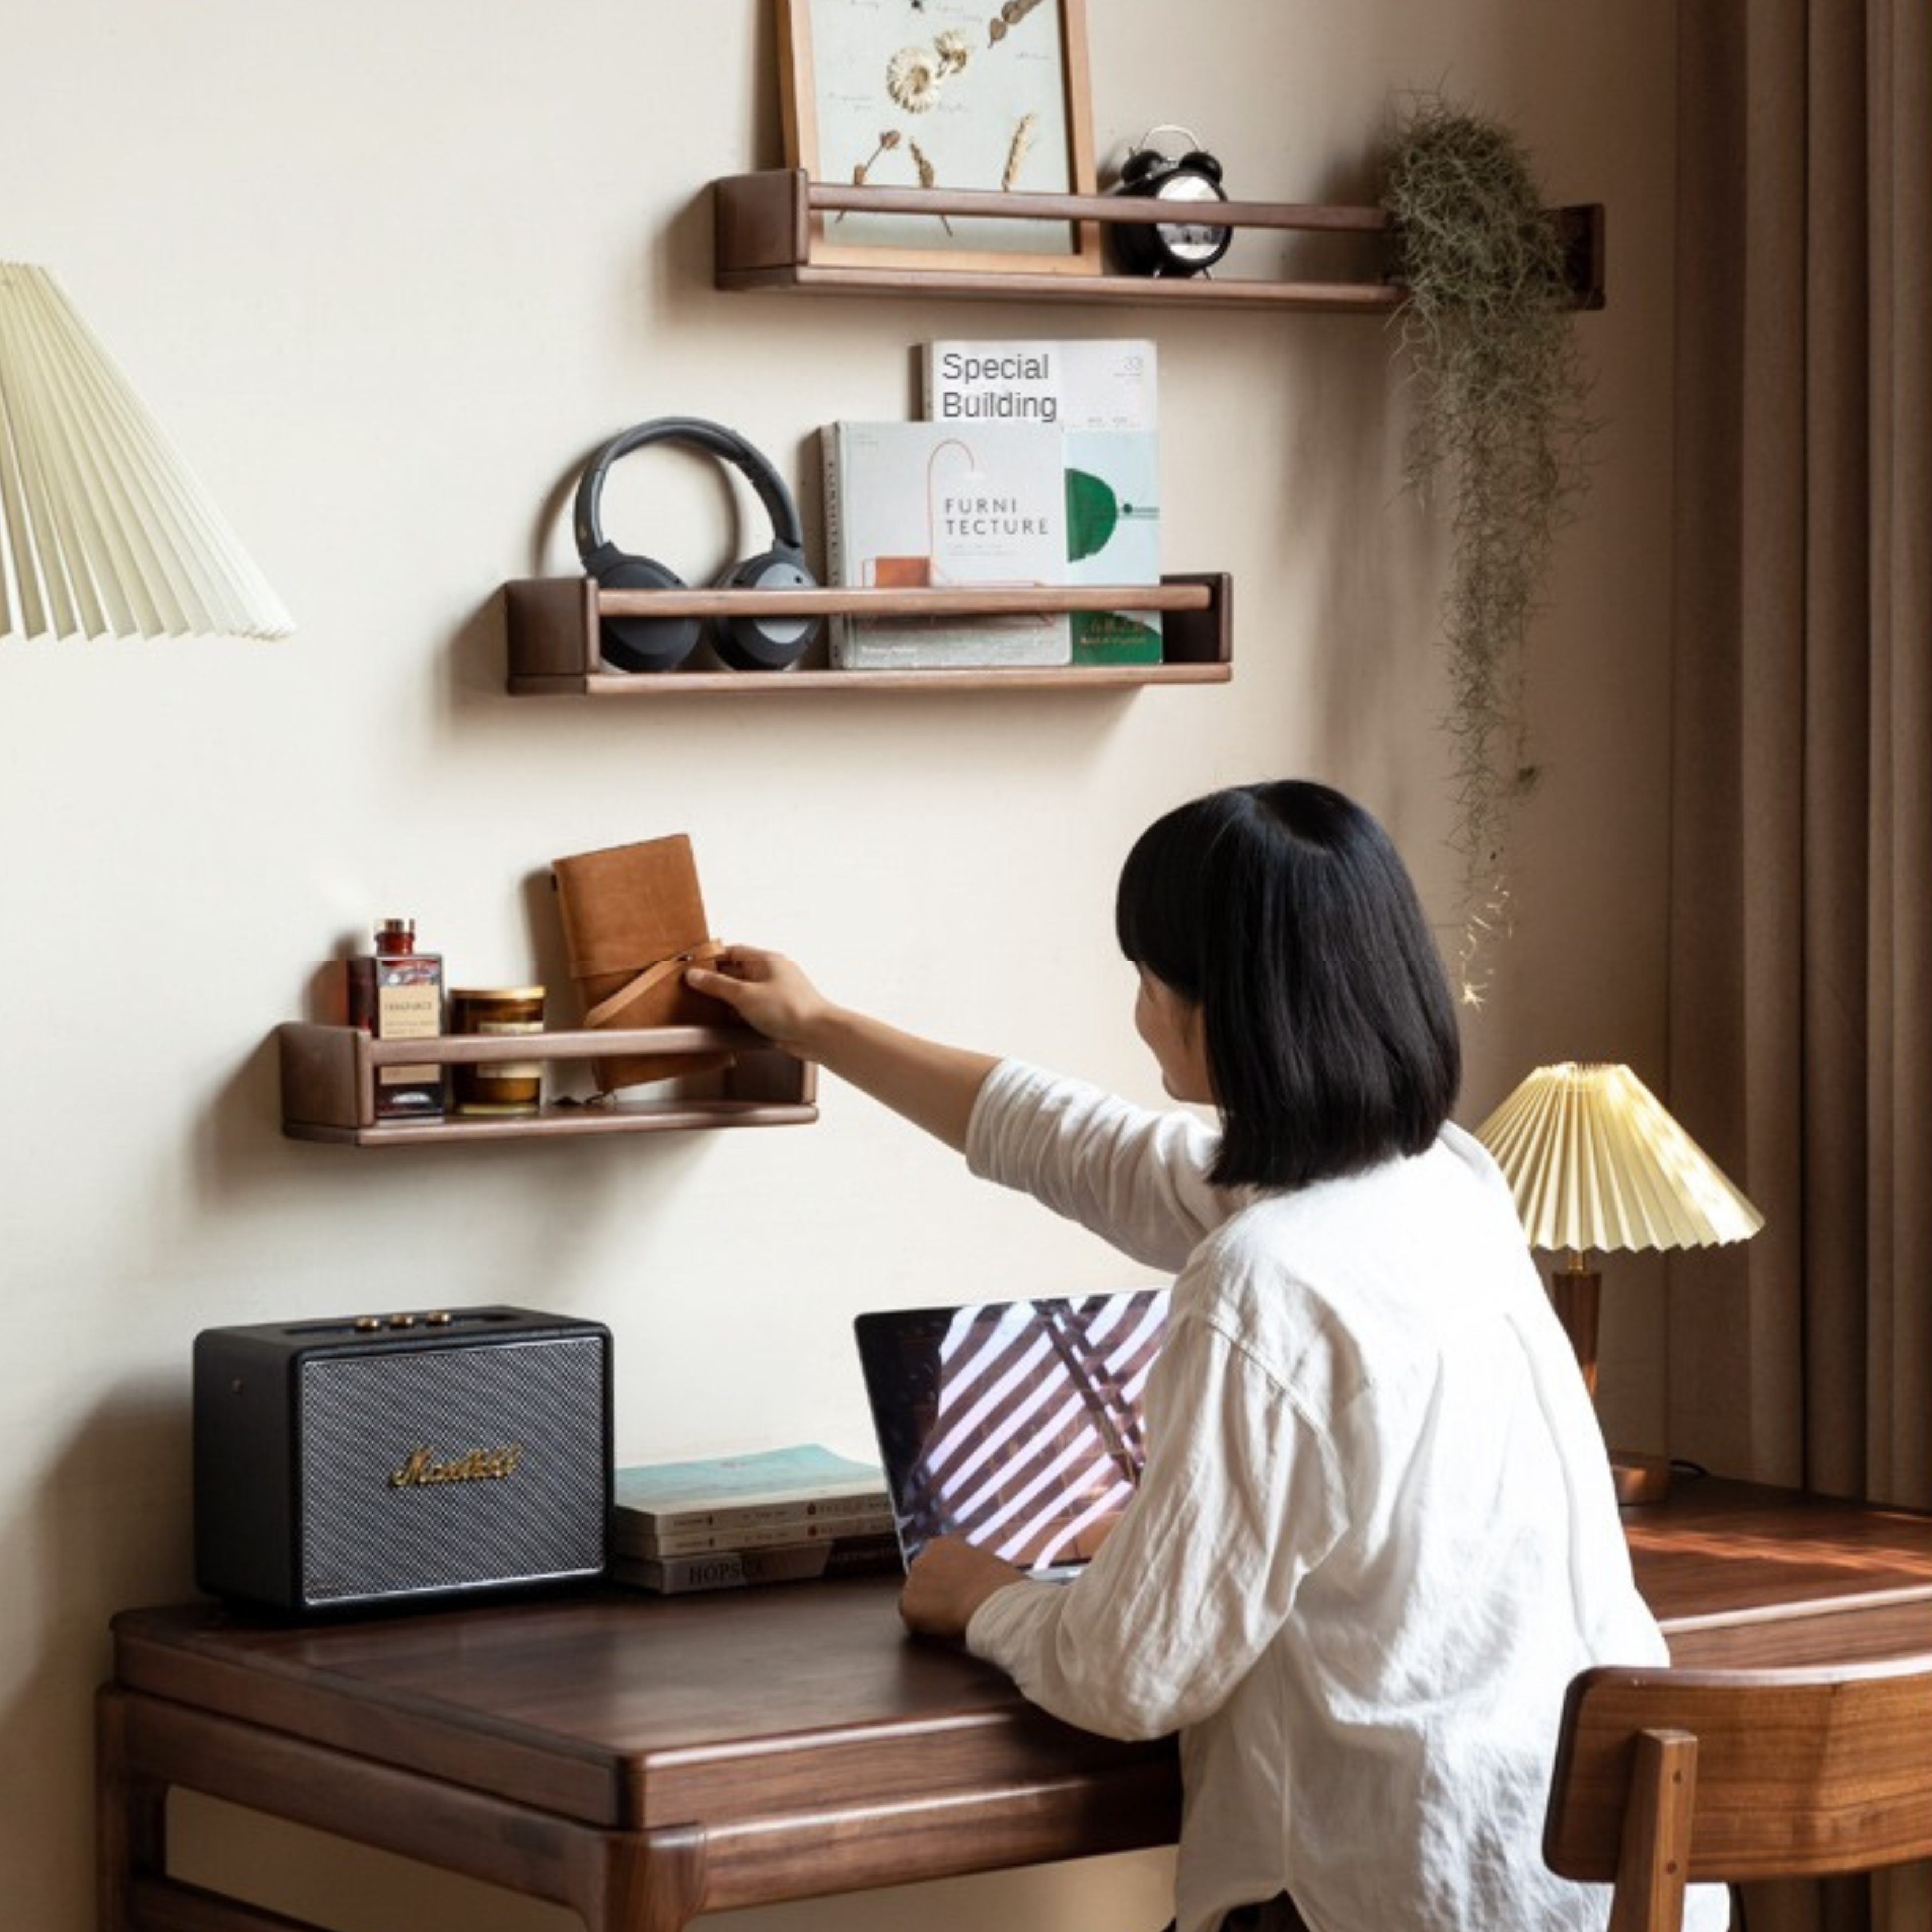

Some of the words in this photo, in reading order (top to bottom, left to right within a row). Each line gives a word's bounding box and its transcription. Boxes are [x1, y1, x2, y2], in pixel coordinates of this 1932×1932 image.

[942, 353, 1049, 384] Special
[942, 392, 1057, 423] Building
[945, 497, 1017, 513] FURNI
[945, 519, 1049, 535] TECTURE
